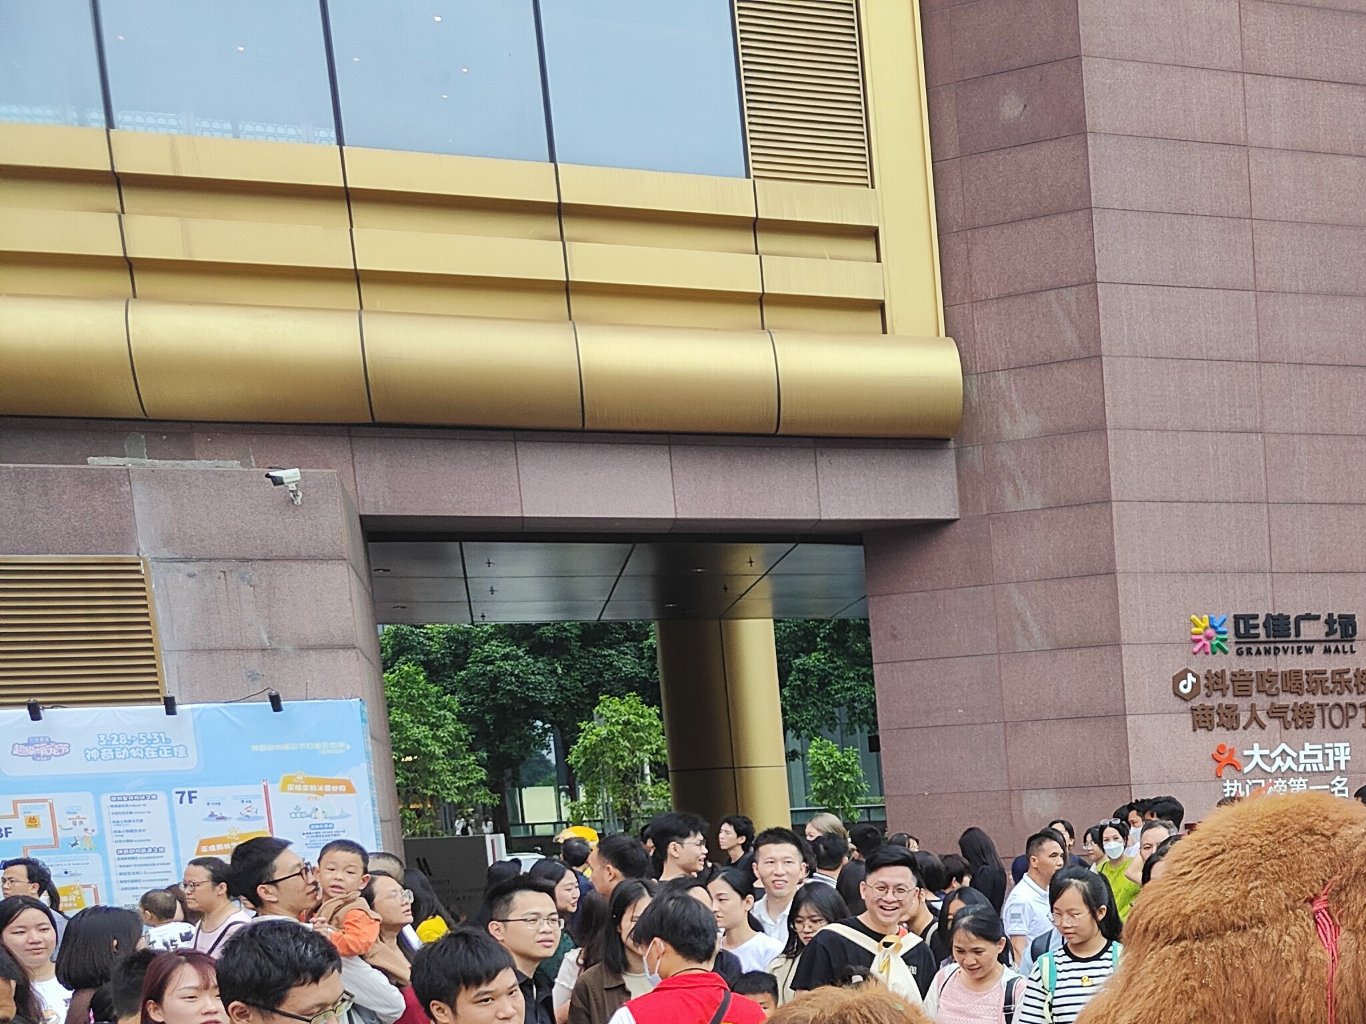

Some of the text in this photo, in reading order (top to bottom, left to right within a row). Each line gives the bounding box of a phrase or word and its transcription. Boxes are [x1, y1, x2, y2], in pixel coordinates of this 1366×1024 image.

[1233, 613, 1358, 639] 正佳广场
[1235, 643, 1357, 657] GRANDVIEW MALL
[1243, 742, 1351, 774] 大众点评
[175, 790, 198, 805] 7F
